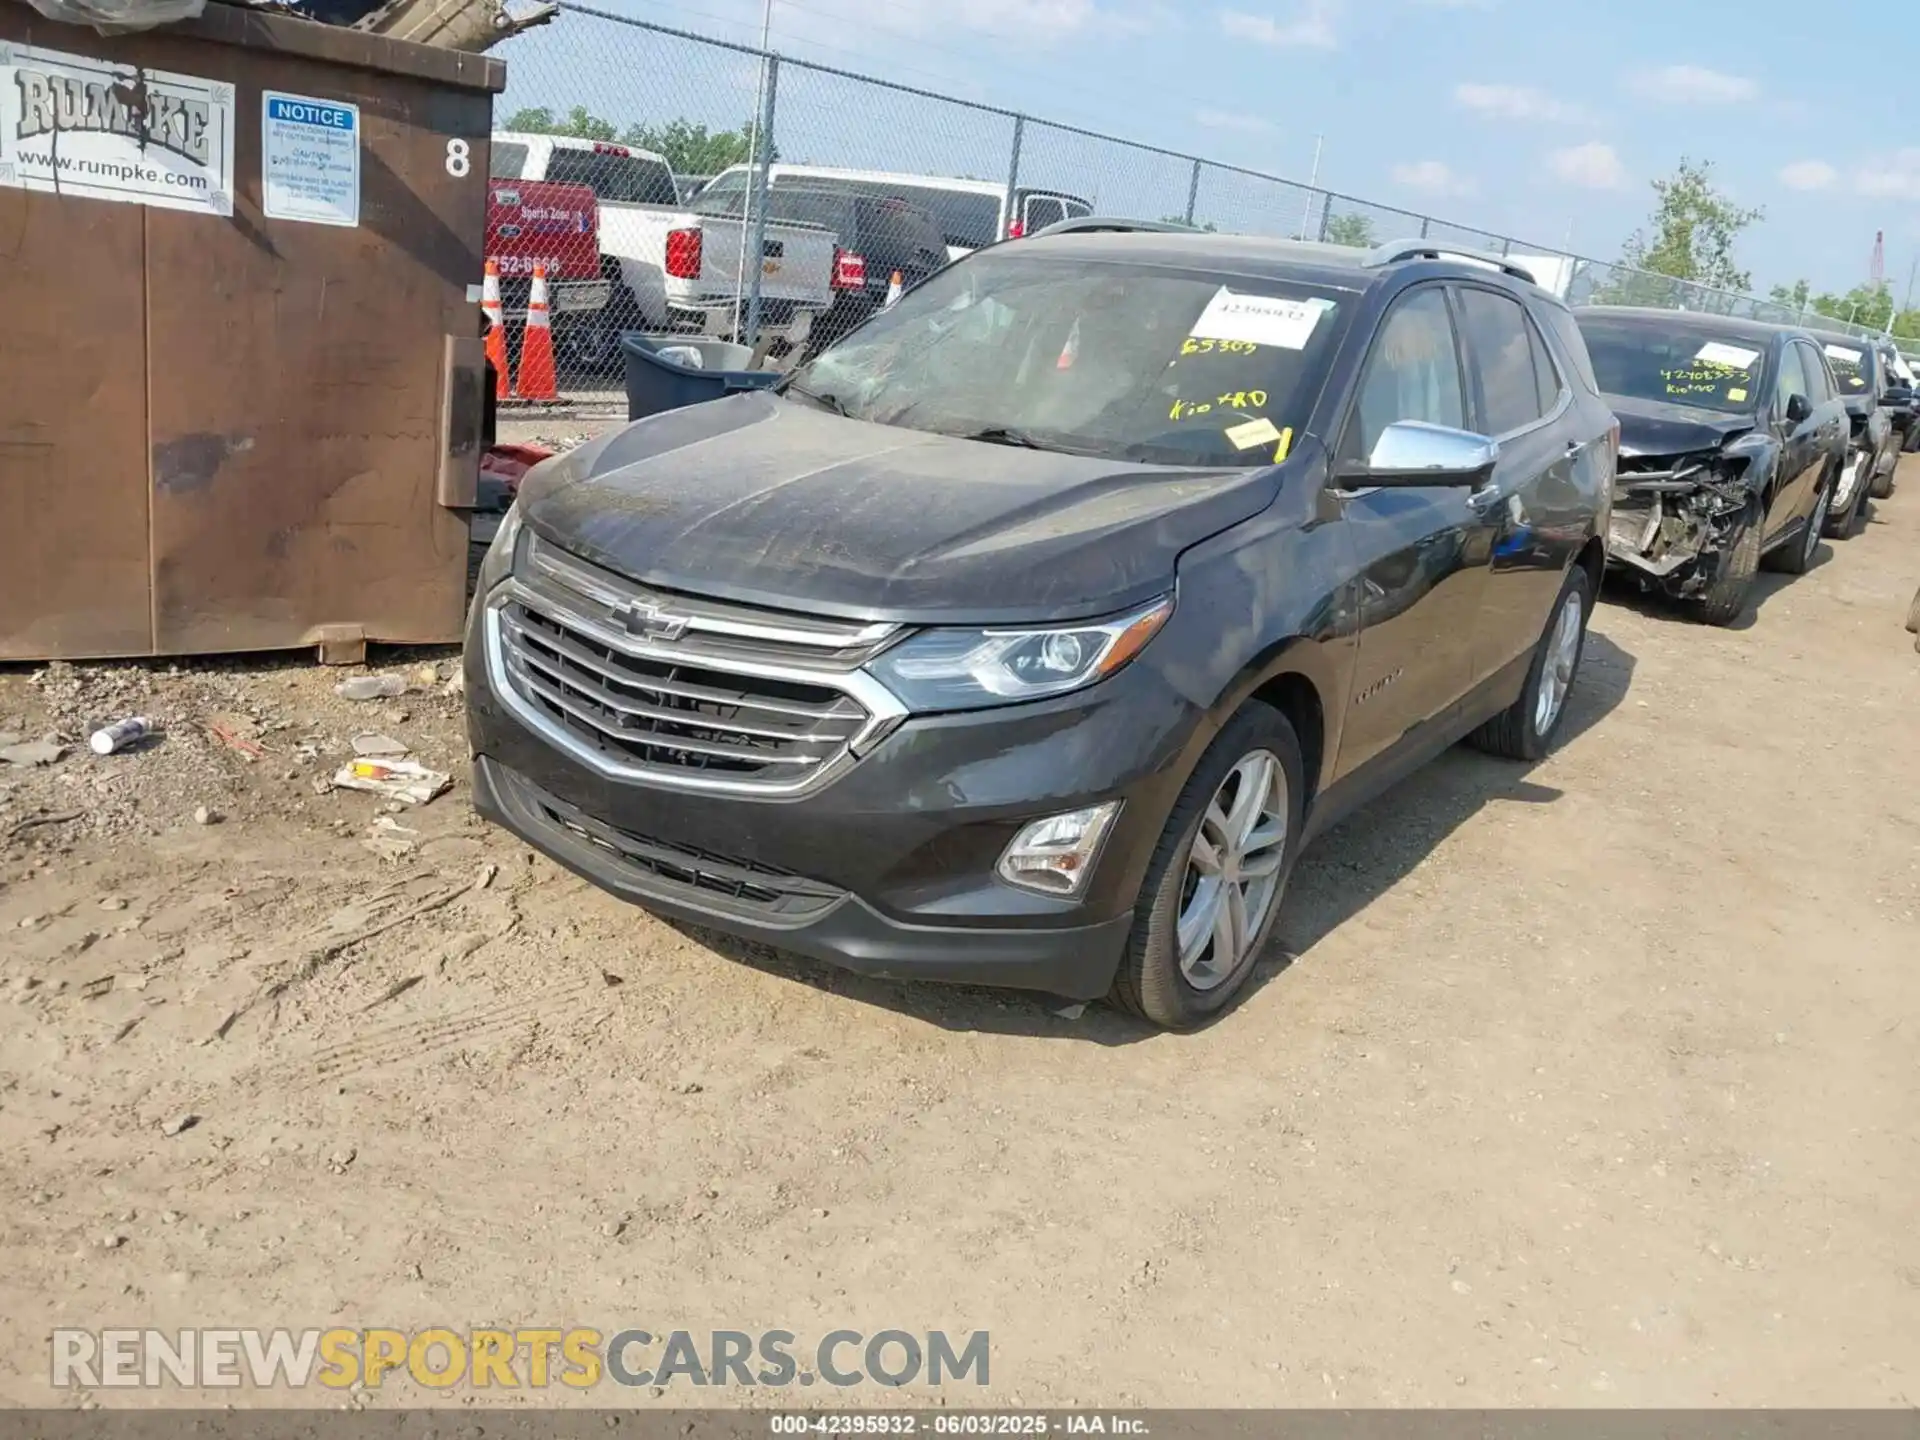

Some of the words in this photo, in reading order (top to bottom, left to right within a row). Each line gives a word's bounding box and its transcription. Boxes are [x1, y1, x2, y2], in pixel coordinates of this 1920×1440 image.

[15, 69, 209, 166] RUMKE
[278, 103, 345, 127] NOTICE
[17, 150, 207, 189] www.rumpke.com
[445, 138, 470, 177] 8
